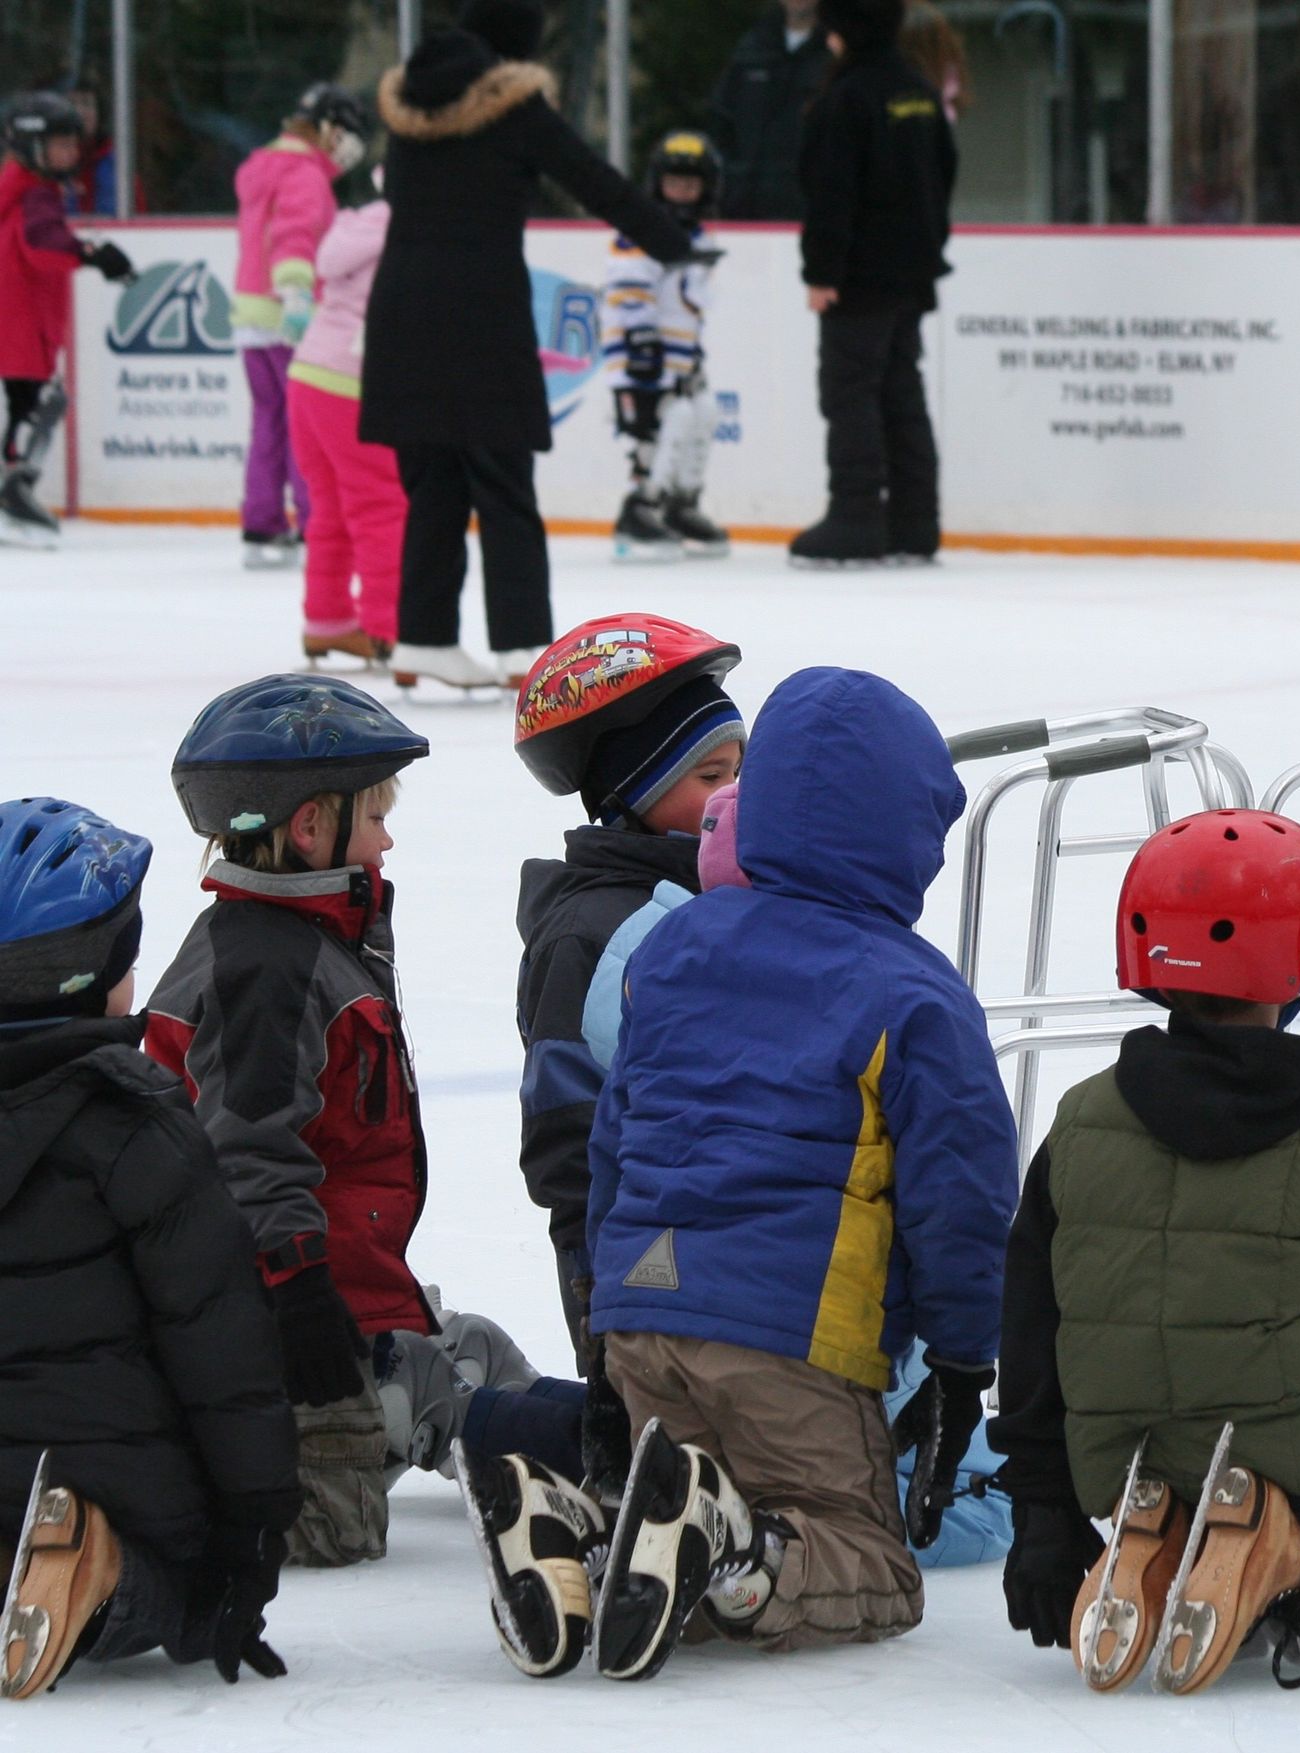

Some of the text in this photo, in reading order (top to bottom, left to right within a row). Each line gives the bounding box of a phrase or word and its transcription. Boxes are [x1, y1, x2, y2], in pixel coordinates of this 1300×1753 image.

[956, 315, 1030, 338] GENERAL
[1033, 317, 1111, 338] WELDING
[1115, 318, 1128, 338] &
[1032, 350, 1088, 371] MAPLE
[1091, 351, 1140, 372] ROAD
[1212, 353, 1235, 372] NY
[116, 367, 228, 392] Aurora Ice
[118, 396, 228, 418] Association
[103, 436, 243, 464] thinkrink.org
